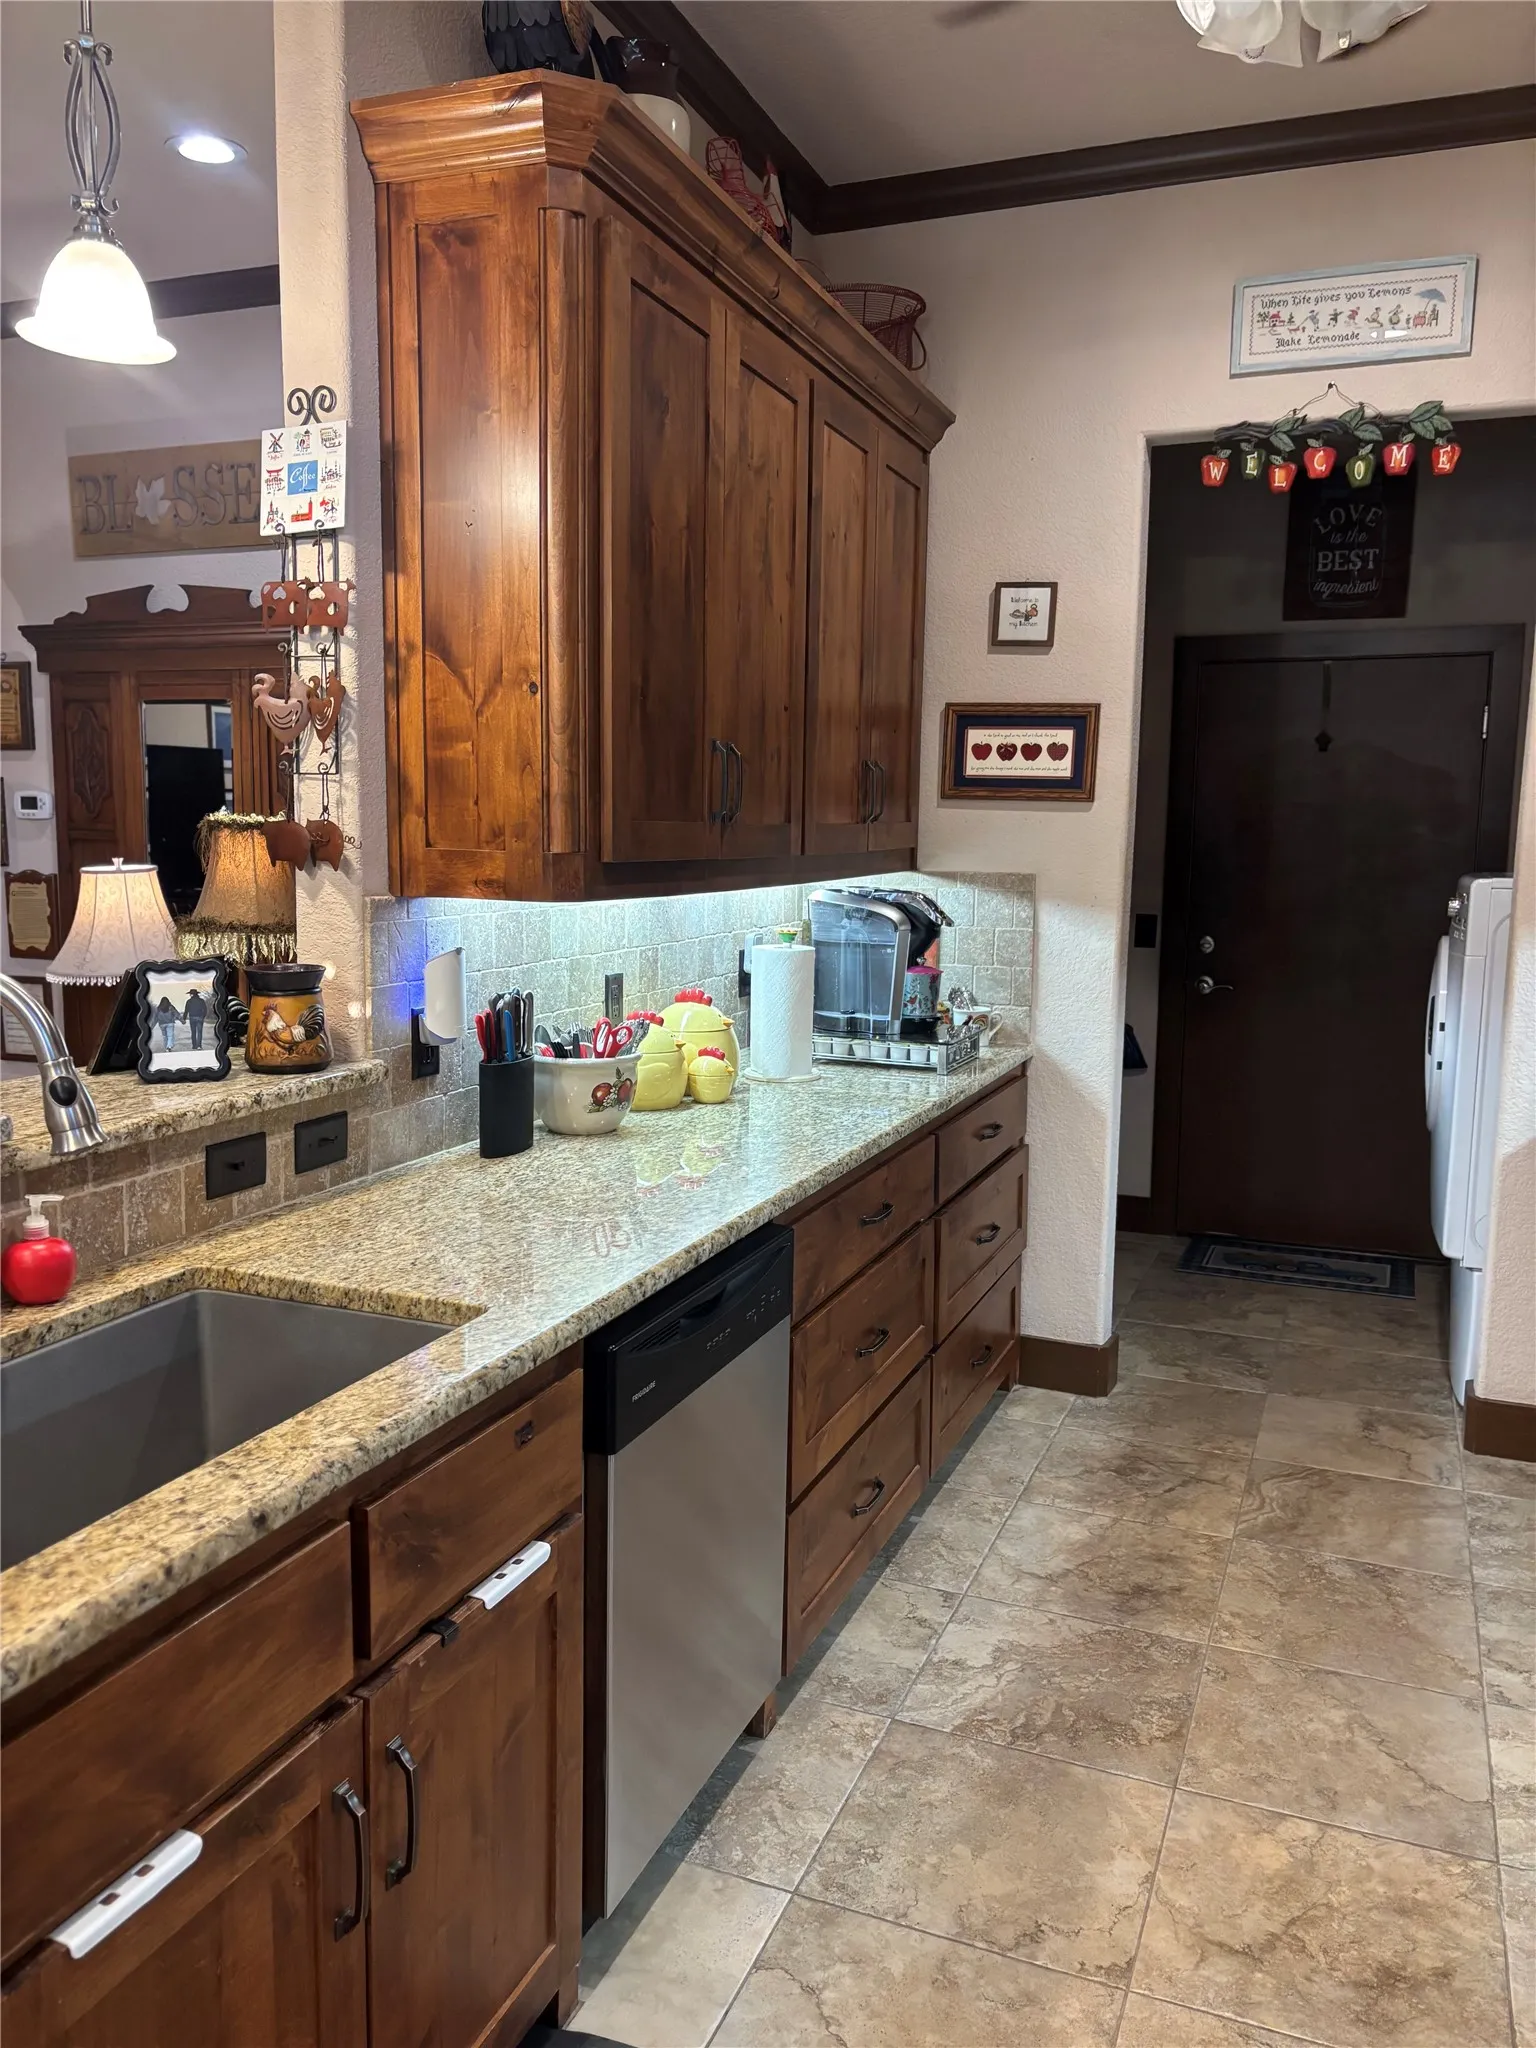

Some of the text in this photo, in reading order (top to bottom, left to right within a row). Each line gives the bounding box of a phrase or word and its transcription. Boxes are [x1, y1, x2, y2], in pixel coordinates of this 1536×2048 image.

[1261, 298, 1289, 309] When
[1291, 295, 1311, 306] Life
[1314, 293, 1341, 306] gives
[1367, 286, 1412, 299] Lemons
[1275, 331, 1360, 348] Make Lemonade
[289, 463, 317, 491] Coffee
[1209, 444, 1452, 488] WELCOME
[1313, 503, 1383, 535] LOVE
[1330, 526, 1368, 544] is the
[1316, 548, 1380, 573] BEST
[1312, 577, 1380, 600] ingredient
